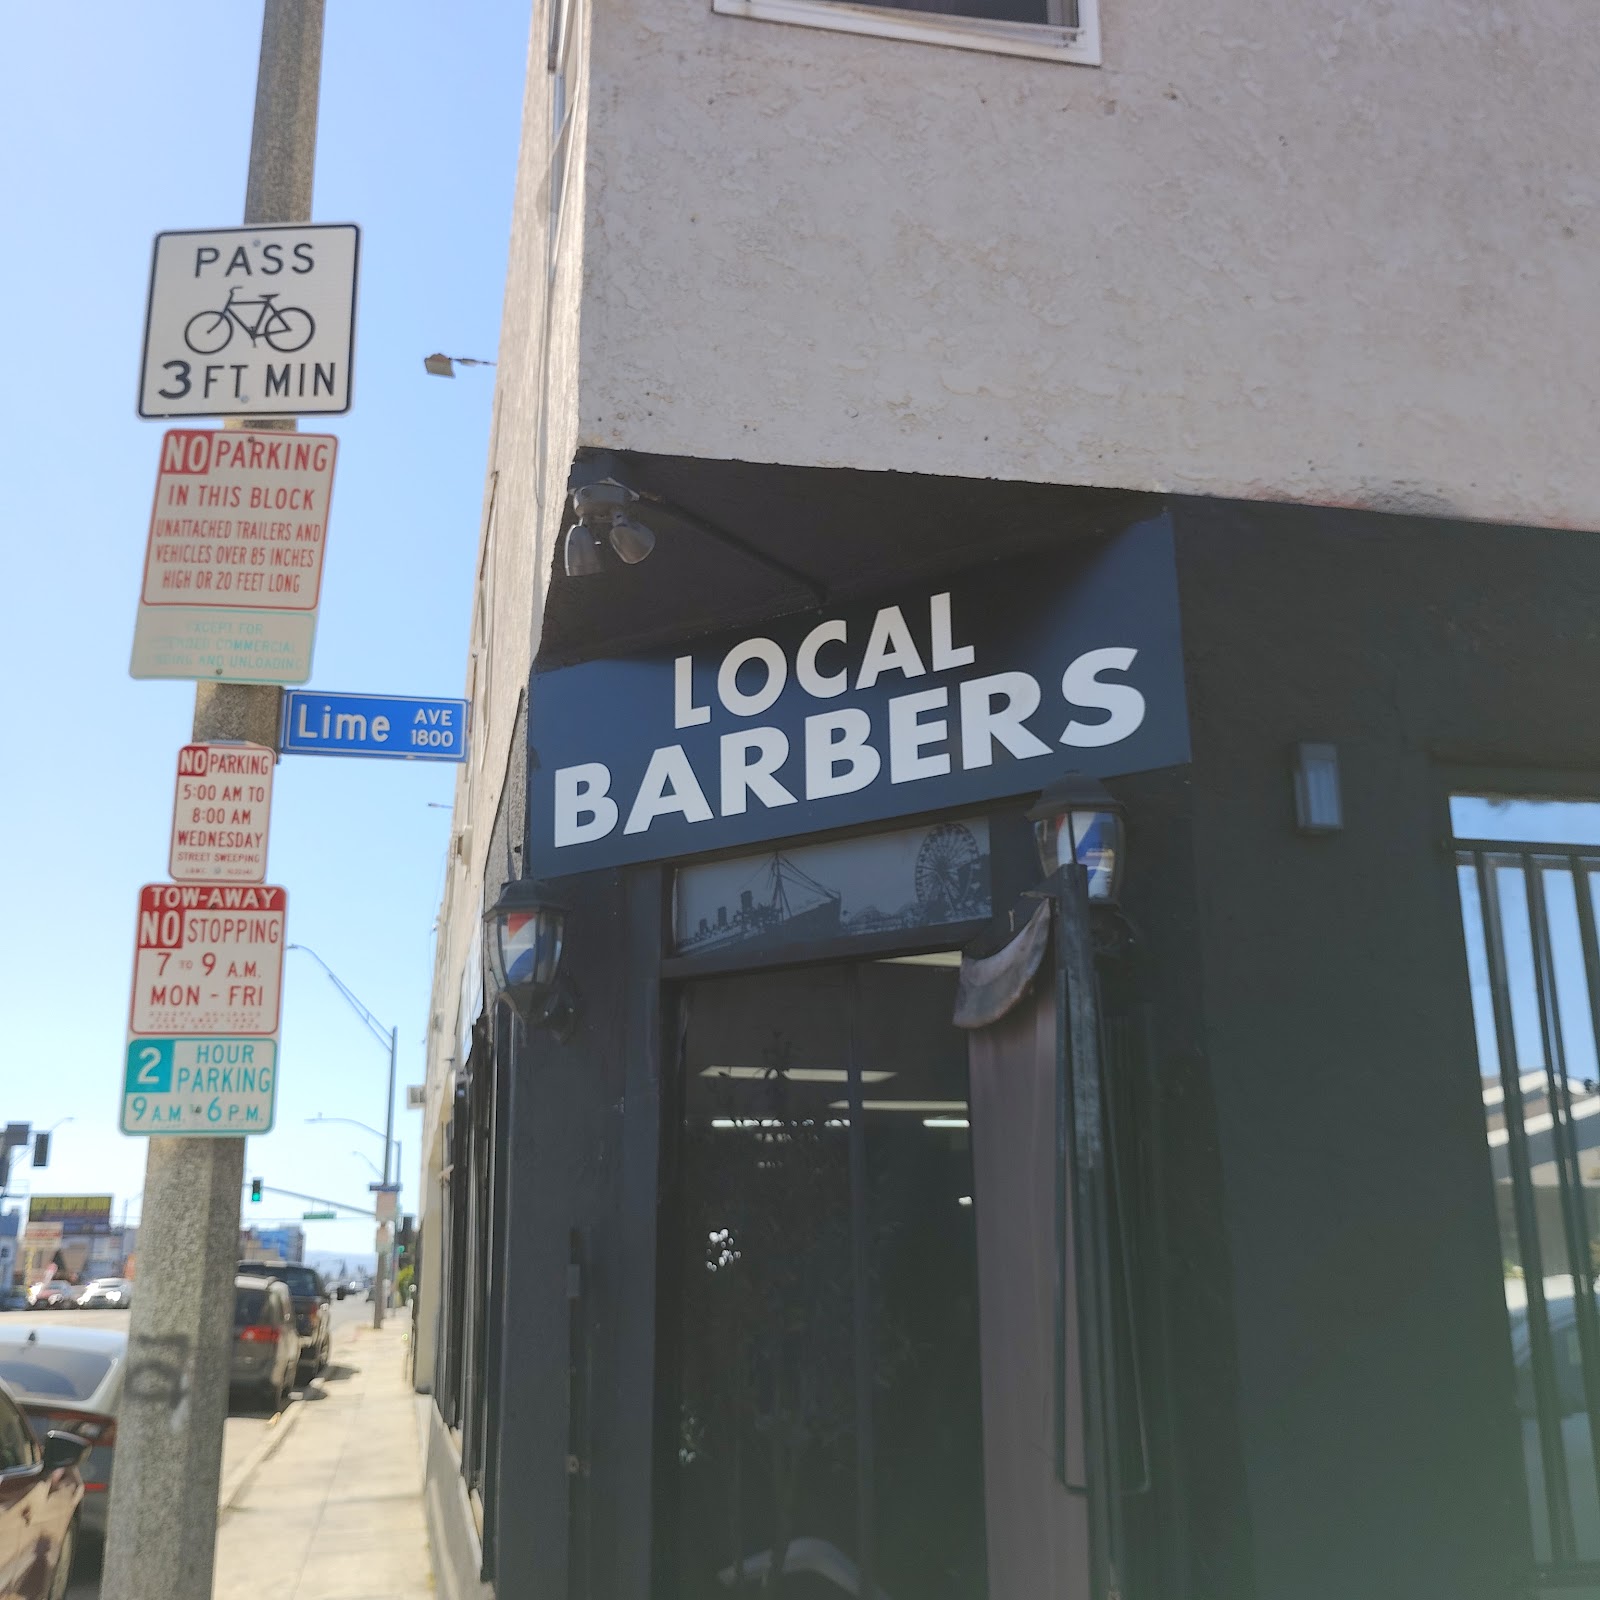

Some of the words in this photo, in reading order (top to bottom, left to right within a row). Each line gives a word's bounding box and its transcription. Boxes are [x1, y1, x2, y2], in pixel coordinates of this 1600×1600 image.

[195, 243, 315, 278] PASS
[158, 360, 192, 399] 3
[204, 364, 248, 399] FT
[265, 362, 336, 398] MIN
[164, 434, 210, 473] NO
[215, 440, 328, 472] PARKING
[167, 485, 189, 506] IN
[198, 485, 242, 508] THIS
[250, 487, 315, 511] BLOCK
[156, 518, 232, 539] UNATTACHED
[237, 520, 292, 541] TRAILERS
[296, 522, 321, 543] AND
[156, 544, 212, 564] VEHICLES
[216, 545, 246, 565] OVER
[250, 547, 266, 566] 85
[269, 548, 314, 568] INCHES
[162, 570, 191, 589] HIGH
[196, 571, 213, 590] OR
[216, 571, 232, 590] 20
[236, 572, 265, 592] FEET
[268, 573, 301, 594] LONG
[673, 591, 976, 730] LOCAL
[298, 703, 391, 742] Lime
[414, 708, 453, 727] AVE
[411, 729, 454, 748] 1800
[553, 646, 1146, 848] BARBERS
[179, 747, 207, 775] NO
[210, 754, 269, 776] PARKING
[183, 783, 216, 801] 5:00
[222, 786, 242, 802] AM
[250, 786, 264, 803] TO
[192, 807, 225, 825] 8:00
[231, 808, 251, 825] AM
[177, 830, 264, 849] WEDNESDAY
[177, 852, 211, 862] STREET
[214, 853, 261, 864] SWEEPING
[151, 887, 278, 910] TOW-AWAY
[140, 910, 181, 947] NO
[187, 918, 280, 944] STOPPING
[157, 952, 172, 977] 7
[179, 960, 192, 970] TO
[201, 952, 217, 976] 9
[227, 960, 262, 978] A.M.
[150, 985, 200, 1006] MON
[228, 985, 263, 1007] FRI
[137, 1046, 162, 1085] 2
[196, 1044, 255, 1064] HOUR
[177, 1067, 271, 1094] PARKING
[132, 1096, 148, 1121] 9
[207, 1096, 223, 1122] 6
